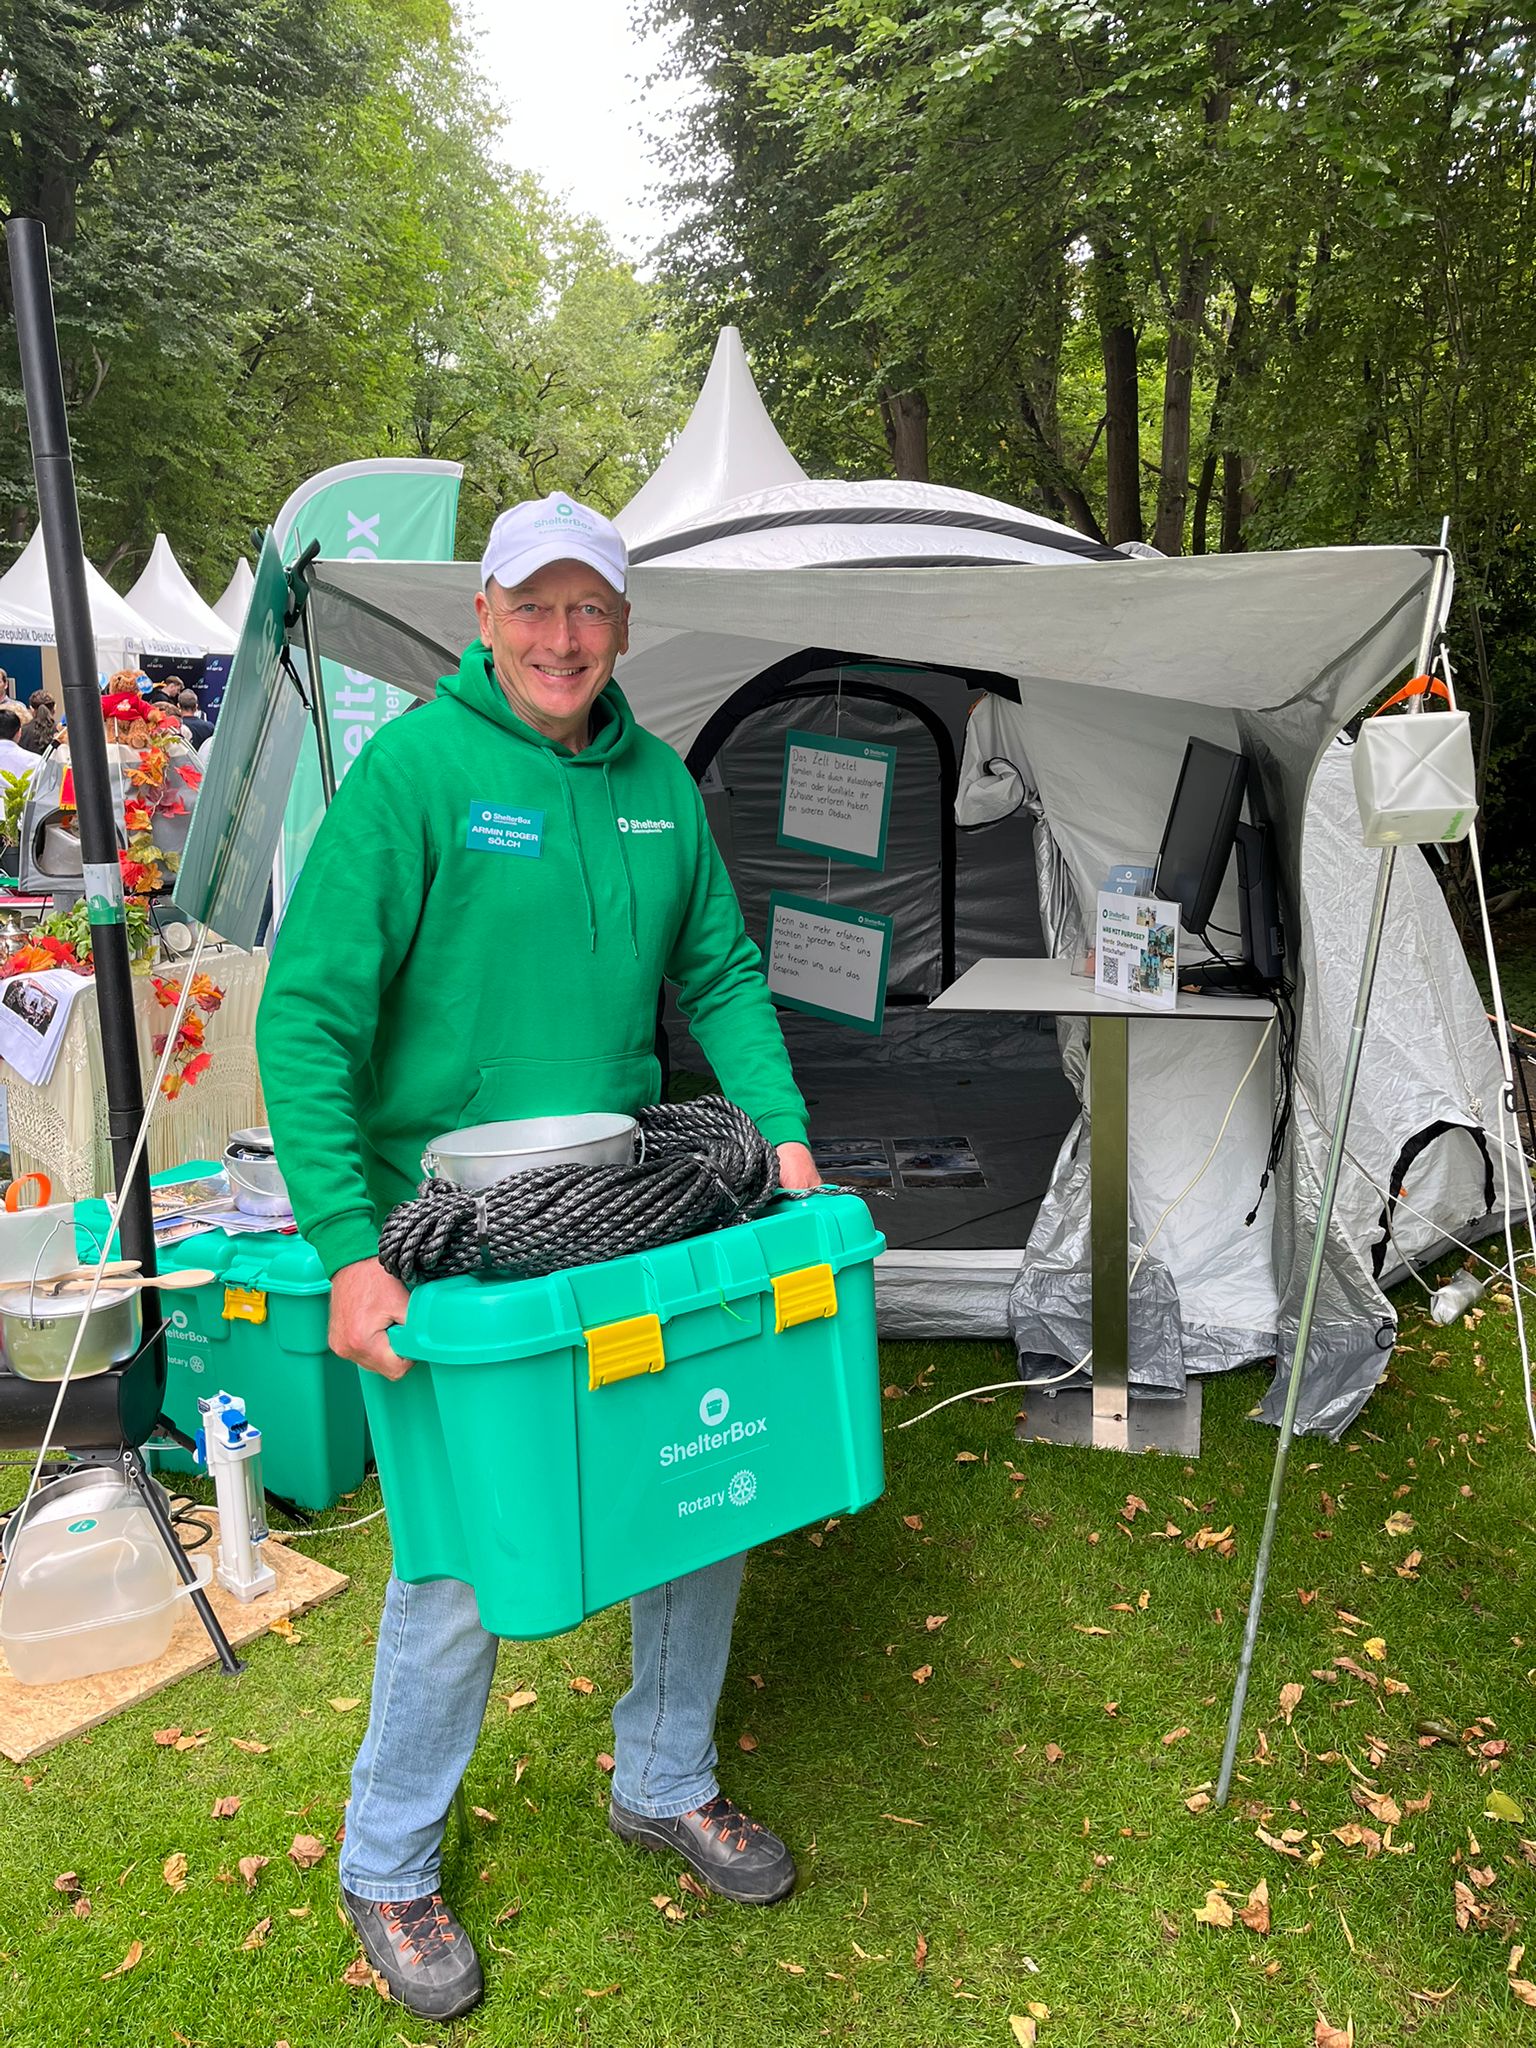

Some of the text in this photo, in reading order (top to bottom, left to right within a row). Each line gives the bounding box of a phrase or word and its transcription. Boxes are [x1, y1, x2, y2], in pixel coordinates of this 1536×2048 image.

[534, 516, 593, 531] ShelterBox
[493, 812, 531, 825] ShelterBox
[471, 825, 539, 843] ARMIN ROGER
[487, 836, 521, 849] SÖLCH
[167, 1354, 189, 1368] otary
[659, 1416, 768, 1467] ShelterBox
[677, 1489, 725, 1518] Rotary
